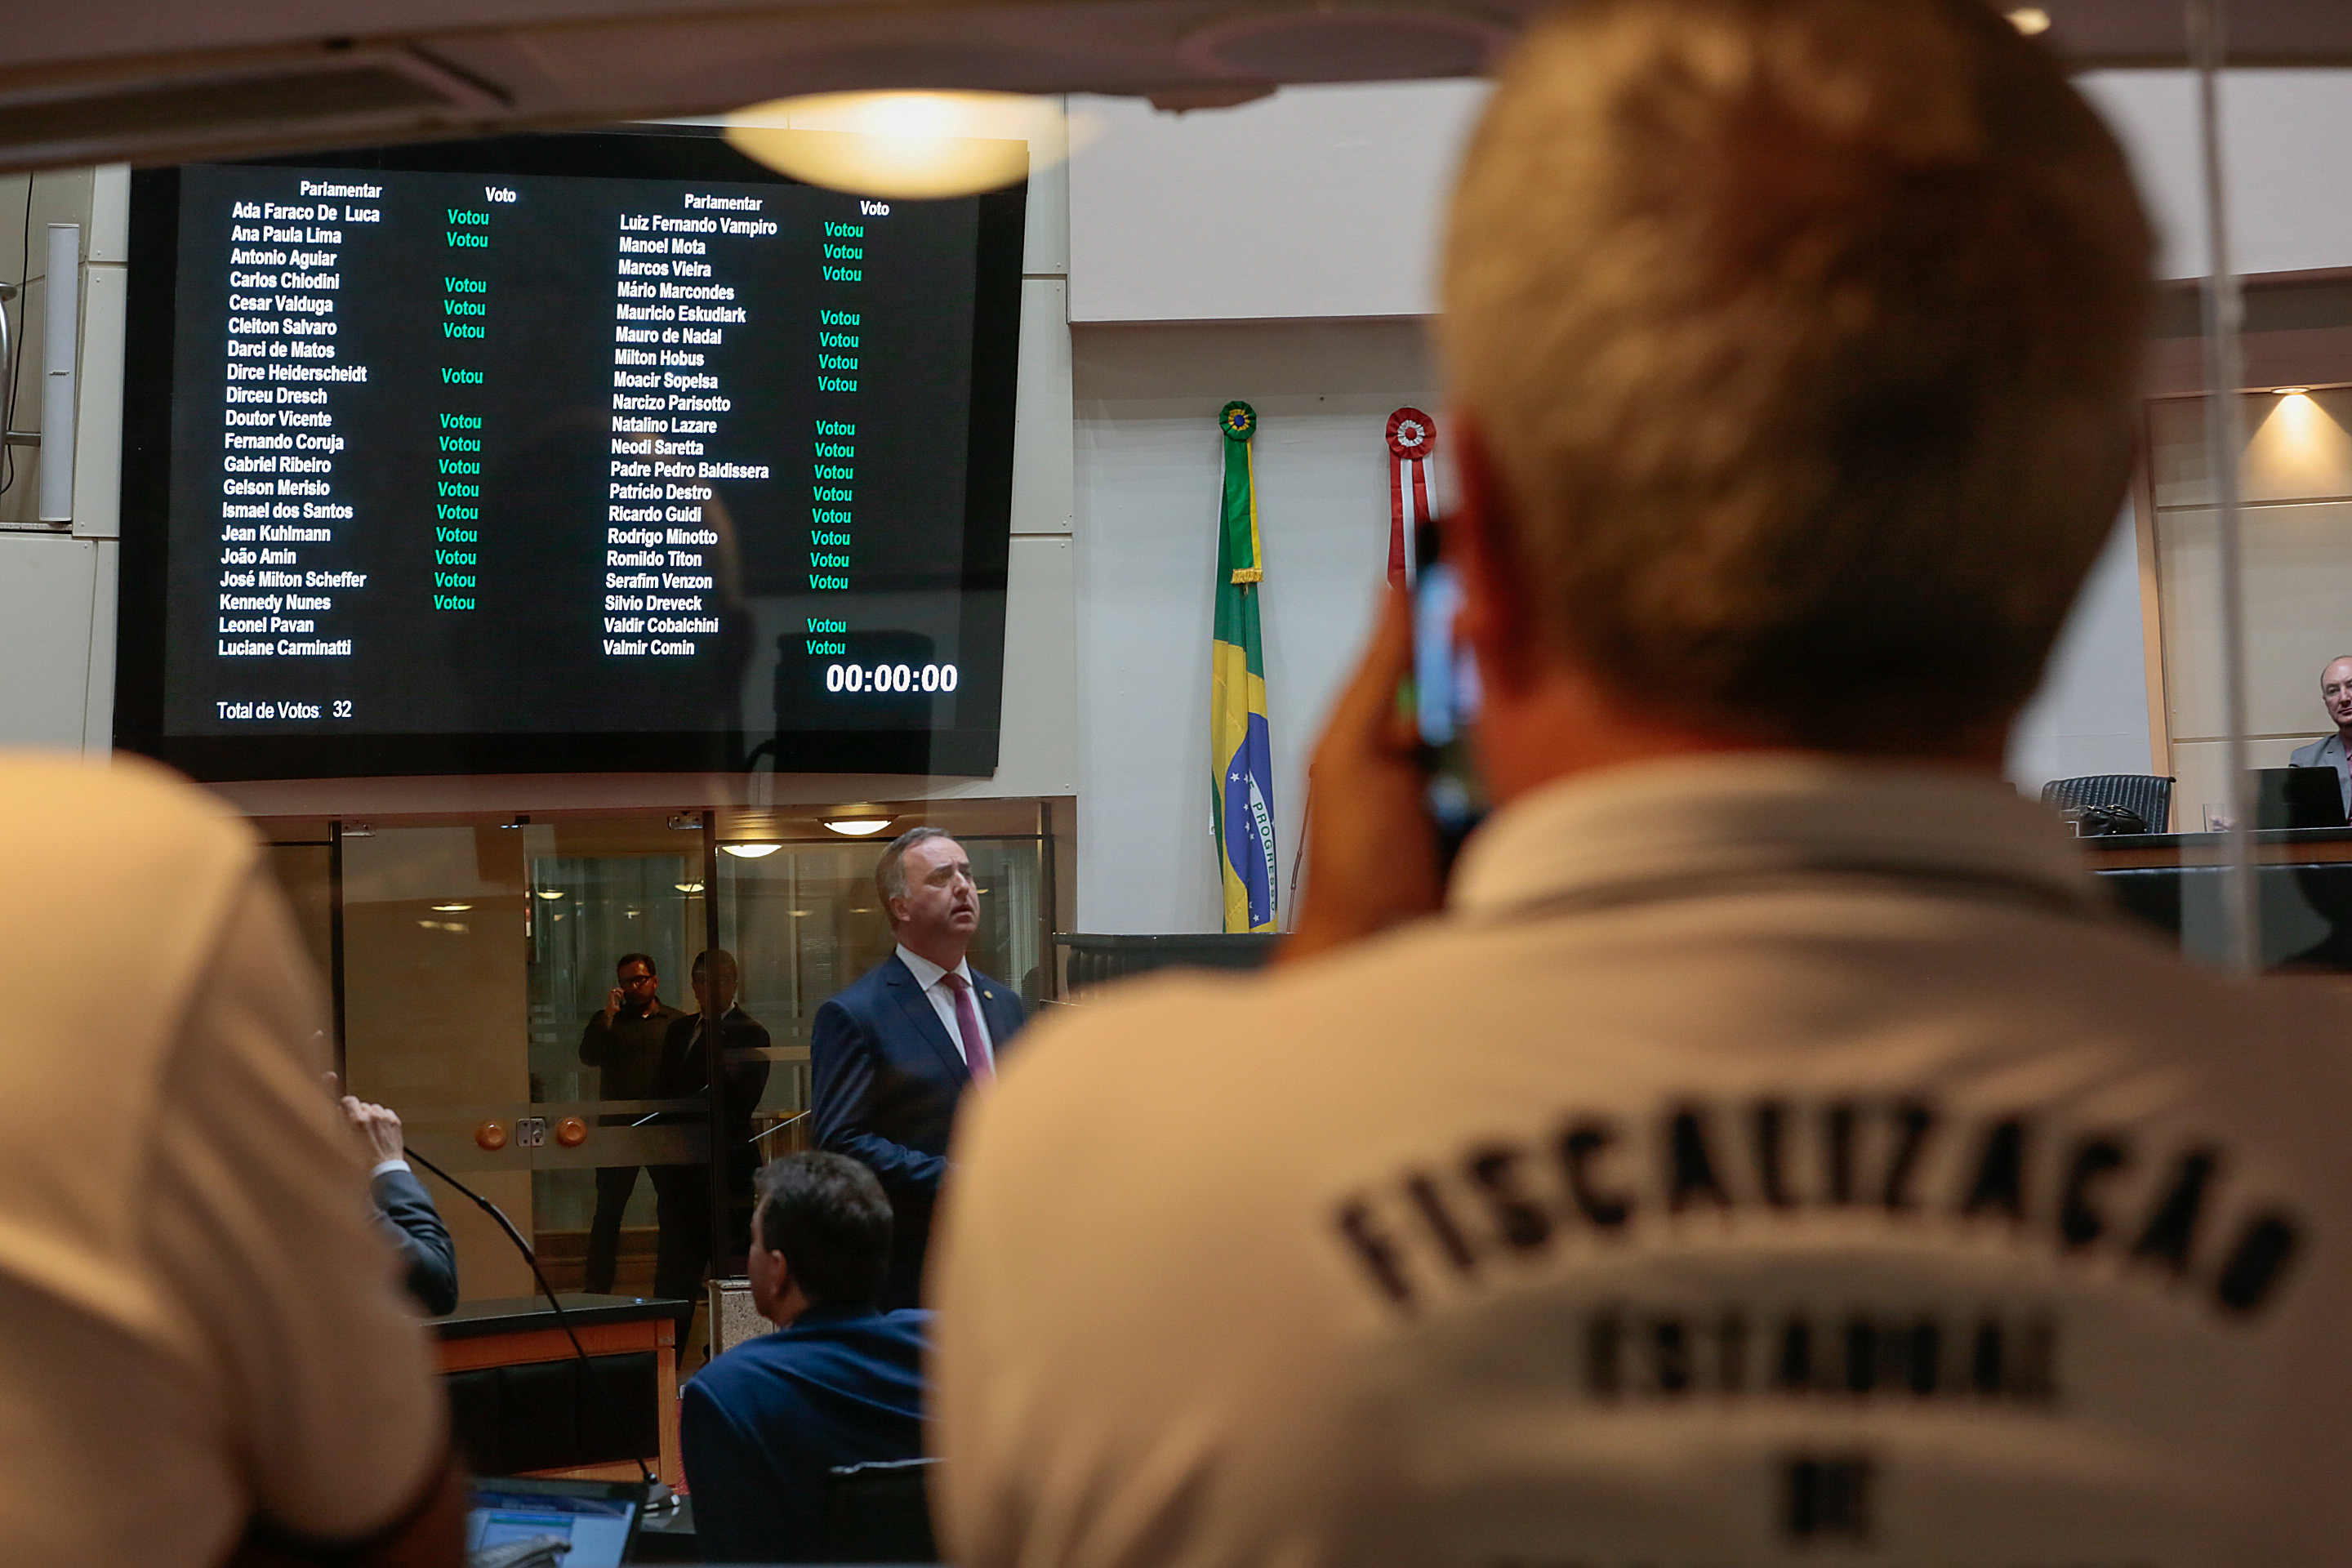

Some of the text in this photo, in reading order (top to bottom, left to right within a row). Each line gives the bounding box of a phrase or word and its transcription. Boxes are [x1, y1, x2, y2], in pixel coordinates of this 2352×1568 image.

[300, 180, 383, 198] Parlamentar
[484, 186, 517, 203] Voto
[684, 193, 764, 212] Parlamentar
[859, 200, 890, 216] Voto
[231, 201, 381, 223] Ada Faraco De Luca
[447, 208, 489, 225] Votou
[620, 213, 777, 238] Luiz Fernando Vampiro
[824, 221, 864, 238] Votou
[230, 225, 342, 244] Ana Paula Lima
[446, 231, 489, 248] Votou
[619, 236, 706, 255] Manoel Mota
[822, 243, 863, 261] Votou
[229, 247, 338, 270] Antonio Aguiar
[618, 258, 711, 278] Marcos Vieira
[822, 265, 862, 282] Votou
[229, 270, 340, 290] Carlos Chiodini
[444, 276, 487, 293] Votou
[617, 280, 735, 301] Mário Marcondes
[229, 293, 333, 316] Cesar Valduga
[443, 299, 486, 316] Votou
[678, 305, 746, 323] Eskudlark
[820, 309, 861, 326] Votou
[228, 317, 338, 336] Cleiton Salvaro
[443, 322, 486, 339] Votou
[615, 326, 722, 345] Mauro de Nadal
[819, 332, 860, 348] Votou
[227, 340, 336, 359] Darci de Matos
[614, 348, 705, 367] Milton Hobus
[818, 354, 858, 370] Votou
[227, 363, 368, 382] Dirce Heiderscheidt
[441, 368, 483, 385] Votou
[613, 371, 719, 392] Moacir Sopelsa
[817, 376, 858, 392] Votou
[226, 385, 327, 404] Dirceu Dresch
[612, 393, 731, 412] Narcizo Parisotto
[225, 409, 332, 427] Doutor Vicente
[439, 412, 483, 430] Votou
[612, 416, 718, 434] Natalino Lazare
[815, 420, 856, 436] Votou
[225, 432, 345, 455] Fernando Coruja
[439, 435, 481, 452] Votou
[611, 438, 704, 456] Neodi Saretta
[814, 442, 855, 458] Votou
[224, 455, 332, 473] Gabriel Ribeiro
[438, 458, 481, 474] Votou
[610, 461, 769, 479] Padre Pedro Baldissera
[813, 464, 854, 480] Votou
[223, 479, 331, 496] Gelson Merisio
[437, 481, 479, 497] Votou
[609, 482, 712, 501] Patrício Destro
[813, 485, 853, 501] Votou
[222, 501, 354, 519] Ismael dos Santos
[436, 503, 479, 520] Votou
[608, 505, 702, 523] Ricardo Guidi
[811, 507, 852, 523] Votou
[220, 524, 332, 541] Jean Kuhlmann
[435, 526, 478, 543] Votou
[608, 528, 719, 548] Rodrigo Minotto
[810, 530, 851, 546] Votou
[220, 547, 296, 564] João Amin
[434, 549, 477, 565] Votou
[606, 550, 702, 567] Romildo Titon
[809, 552, 850, 568] Votou
[220, 569, 368, 588] José Milton Scheffer
[434, 572, 476, 588] Votou
[605, 572, 713, 590] Serafim Venzon
[808, 573, 849, 590] Votou
[220, 593, 332, 614] Kennedy Nunes
[433, 594, 476, 610] Votou
[604, 595, 702, 611] Silvio Dreveck
[219, 616, 314, 633] Leonel Pavan
[604, 617, 719, 633] Valdir Cobalchini
[806, 617, 847, 633] Votou
[218, 639, 352, 656] Luciane Carminatti
[603, 639, 695, 656] Valmir Comin
[805, 639, 846, 655] Votou
[826, 664, 958, 693] 00:00:00
[216, 702, 253, 719] Total
[256, 702, 275, 719] de
[332, 700, 352, 718] 32
